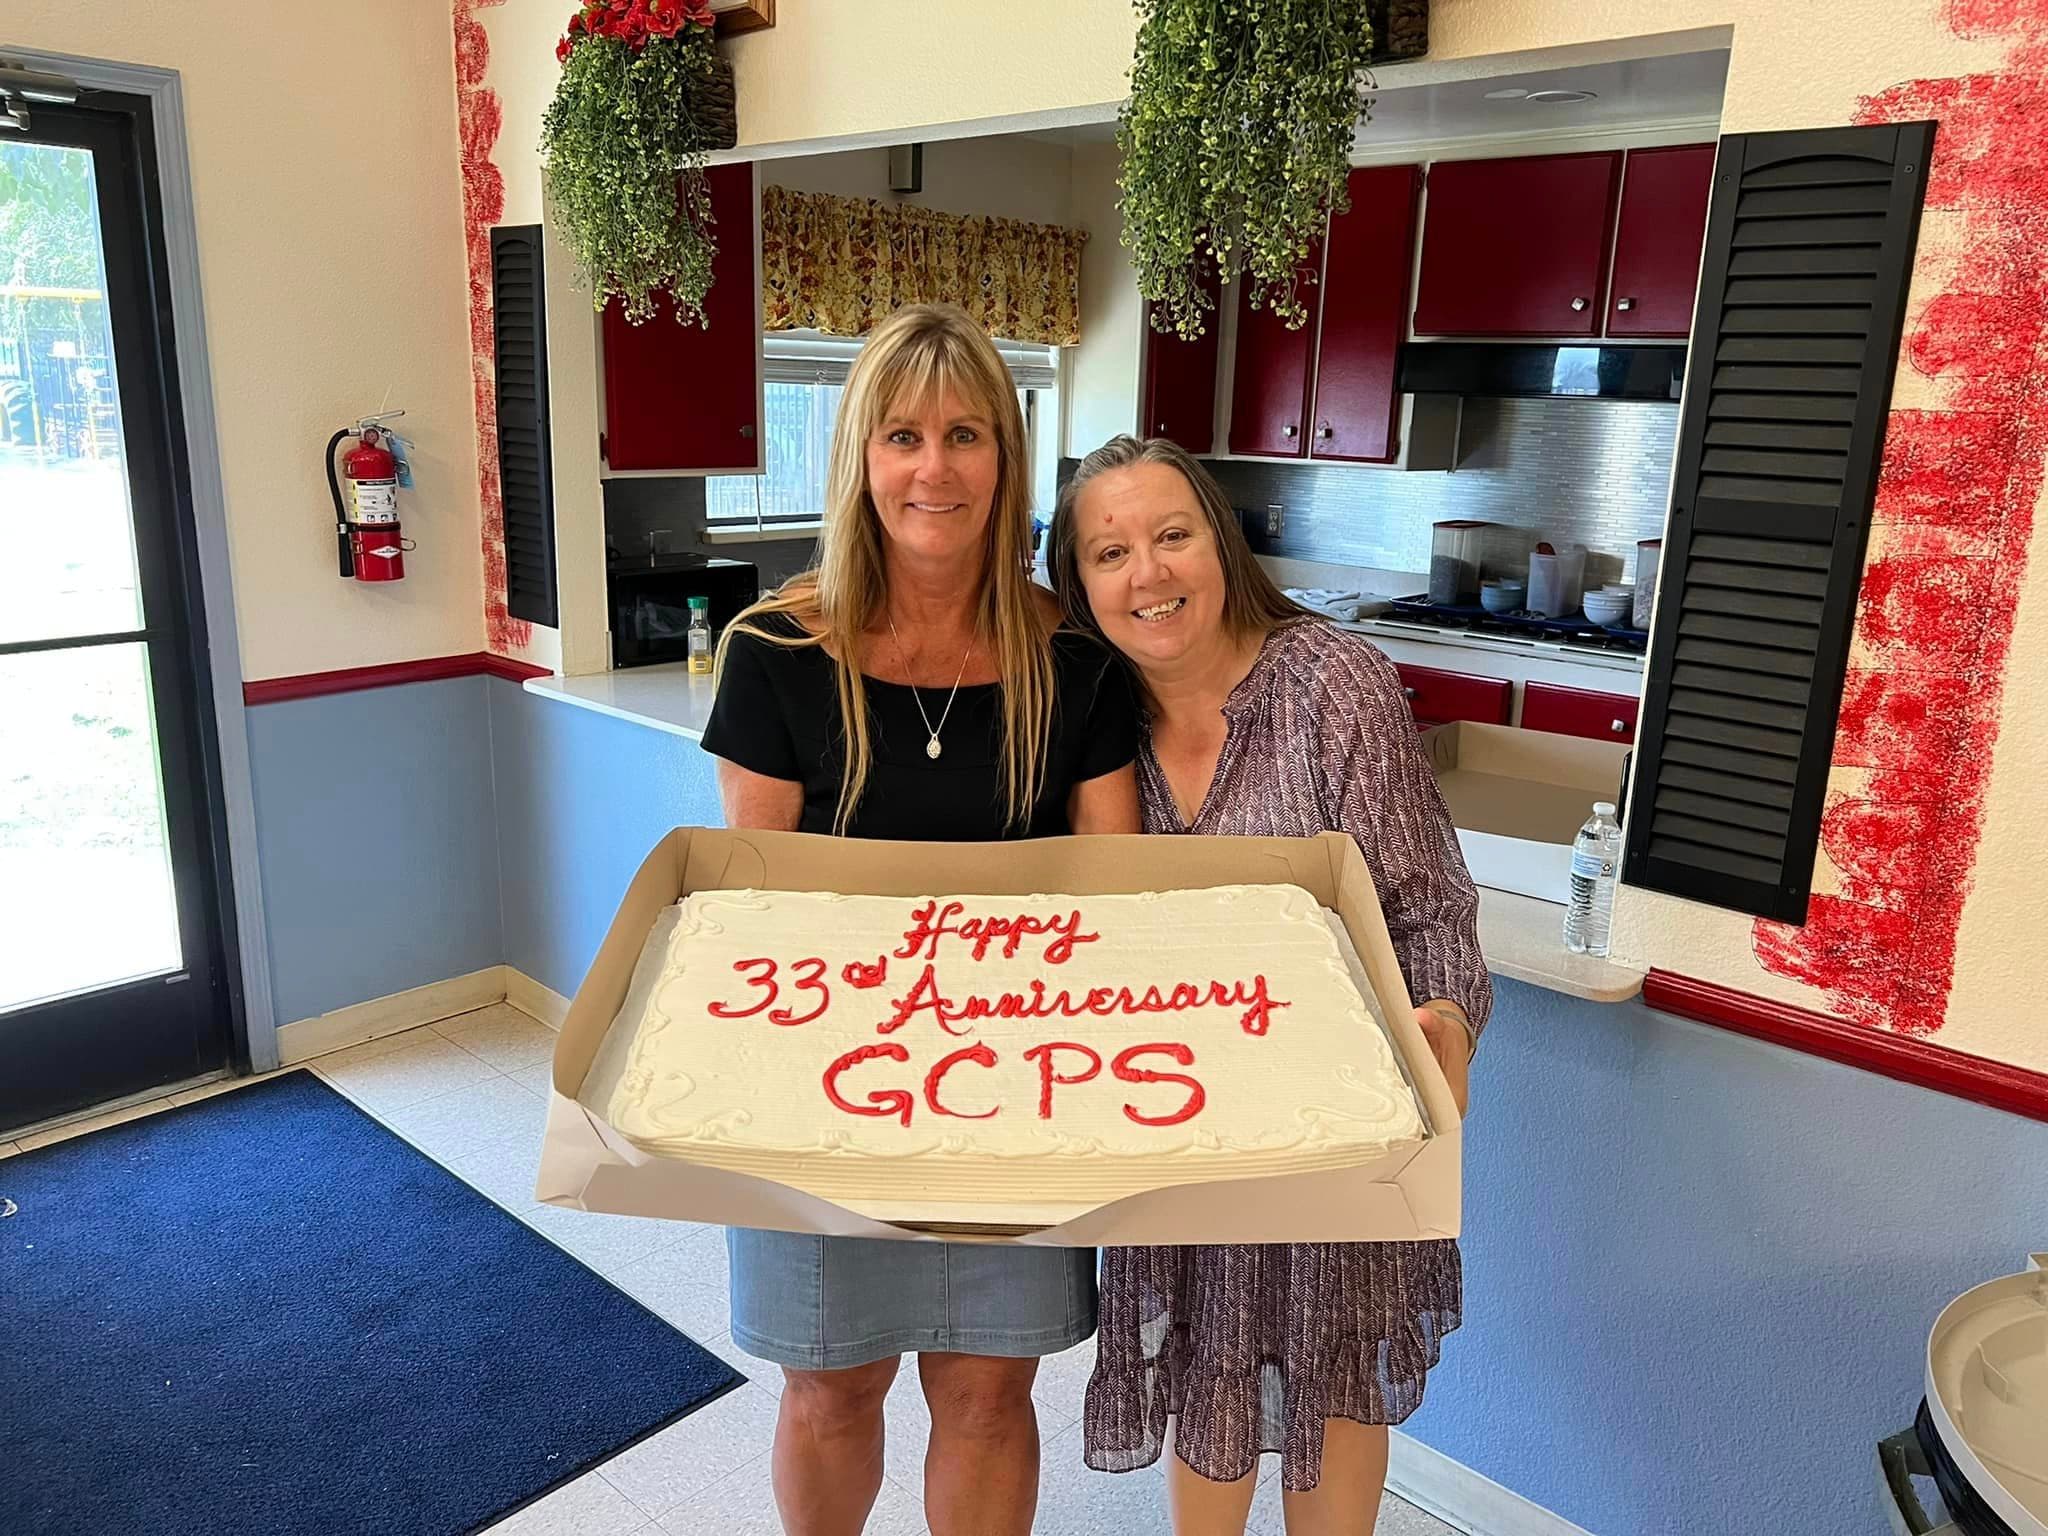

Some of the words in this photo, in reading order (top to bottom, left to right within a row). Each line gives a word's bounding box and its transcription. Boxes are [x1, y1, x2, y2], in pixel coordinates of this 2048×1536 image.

[893, 900, 1100, 963] Happy
[876, 963, 1292, 1036] Anniversary
[821, 1041, 1207, 1128] GCPS
